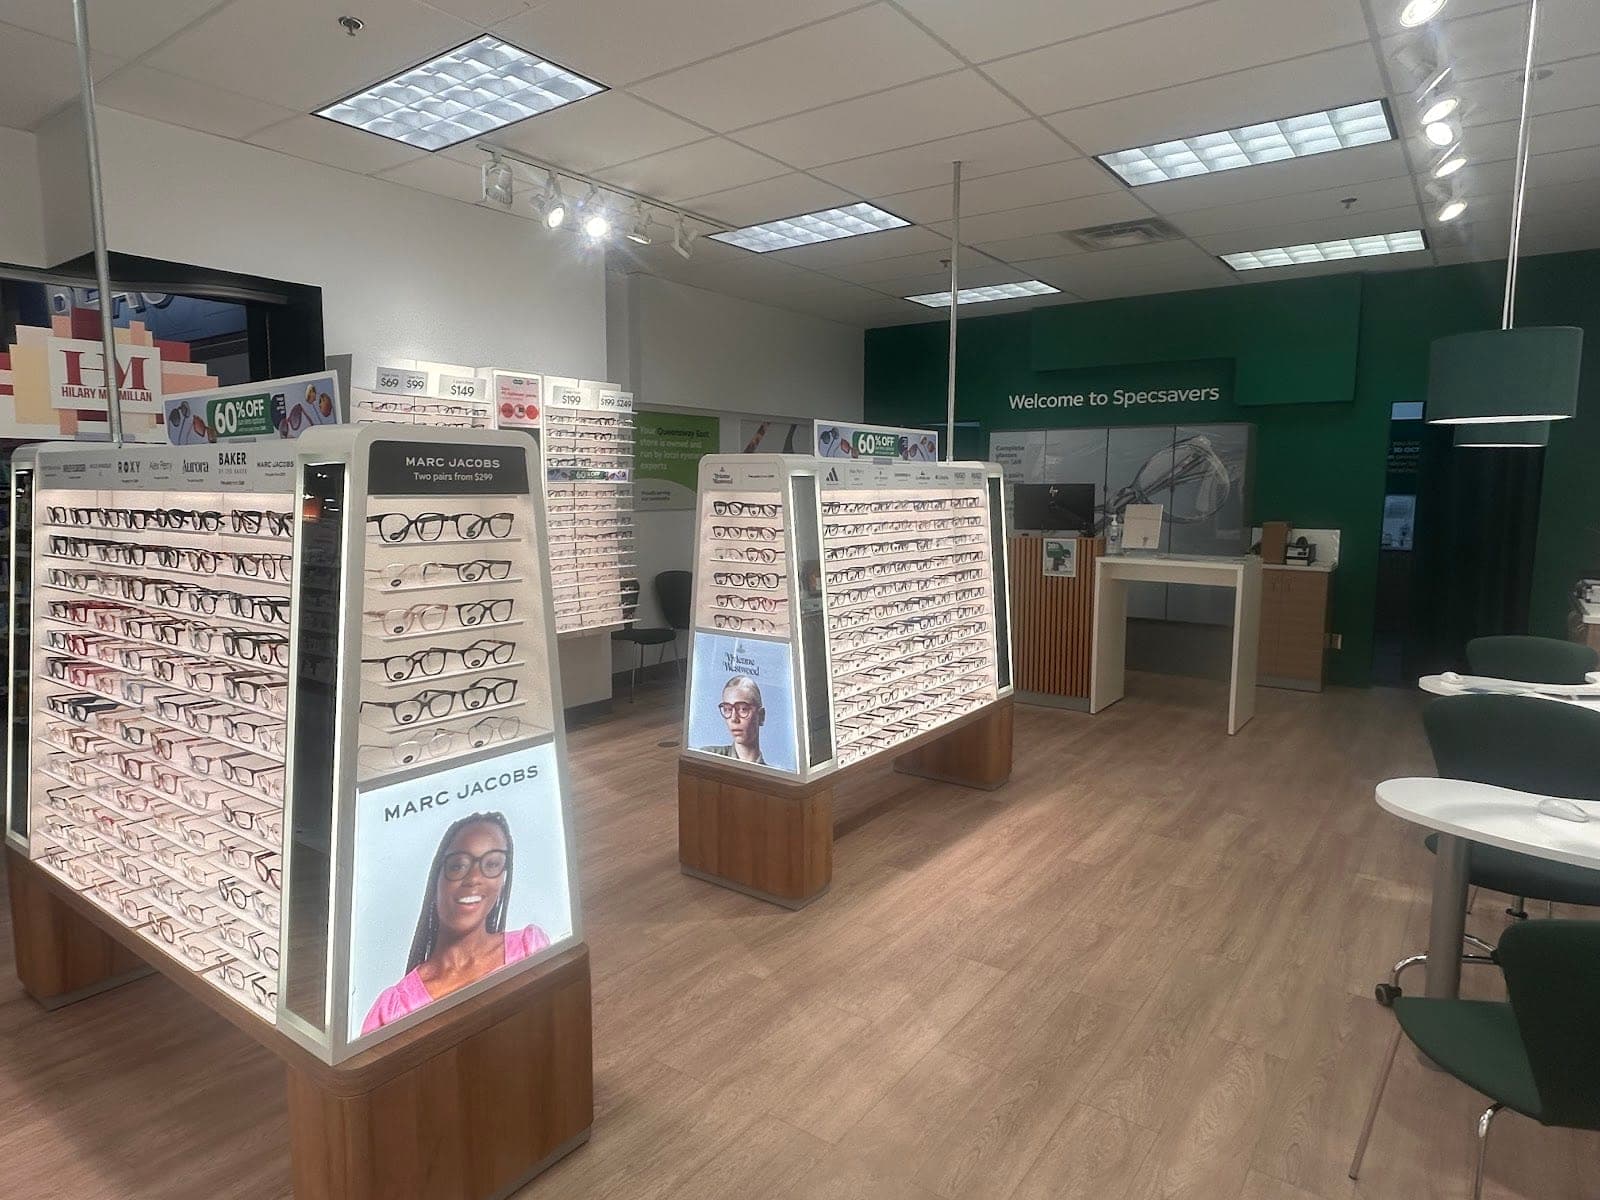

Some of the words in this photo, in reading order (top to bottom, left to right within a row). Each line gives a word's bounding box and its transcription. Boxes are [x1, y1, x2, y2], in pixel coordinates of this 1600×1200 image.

[380, 378, 399, 388] $69
[407, 380, 424, 389] $99
[61, 386, 97, 399] HILARY
[98, 388, 153, 402] MMILLAN
[450, 385, 475, 397] $149
[562, 394, 581, 406] $199
[1008, 393, 1084, 410] Welcome
[1088, 391, 1108, 406] to
[1112, 387, 1220, 409] Specsavers
[214, 400, 246, 434] 60%
[245, 399, 265, 418] OFF
[858, 433, 881, 454] 60%
[881, 436, 896, 447] OFF
[218, 452, 247, 466] BAKER
[404, 456, 445, 467] MARC
[448, 458, 501, 469] JACOBS
[117, 461, 141, 473] ROXY
[183, 459, 209, 474] Aurora
[413, 472, 432, 481] Two
[433, 472, 453, 482] pairs
[454, 472, 473, 481] from
[474, 472, 493, 481] $299
[384, 791, 450, 822] MARC
[457, 765, 539, 800] JACOBS
